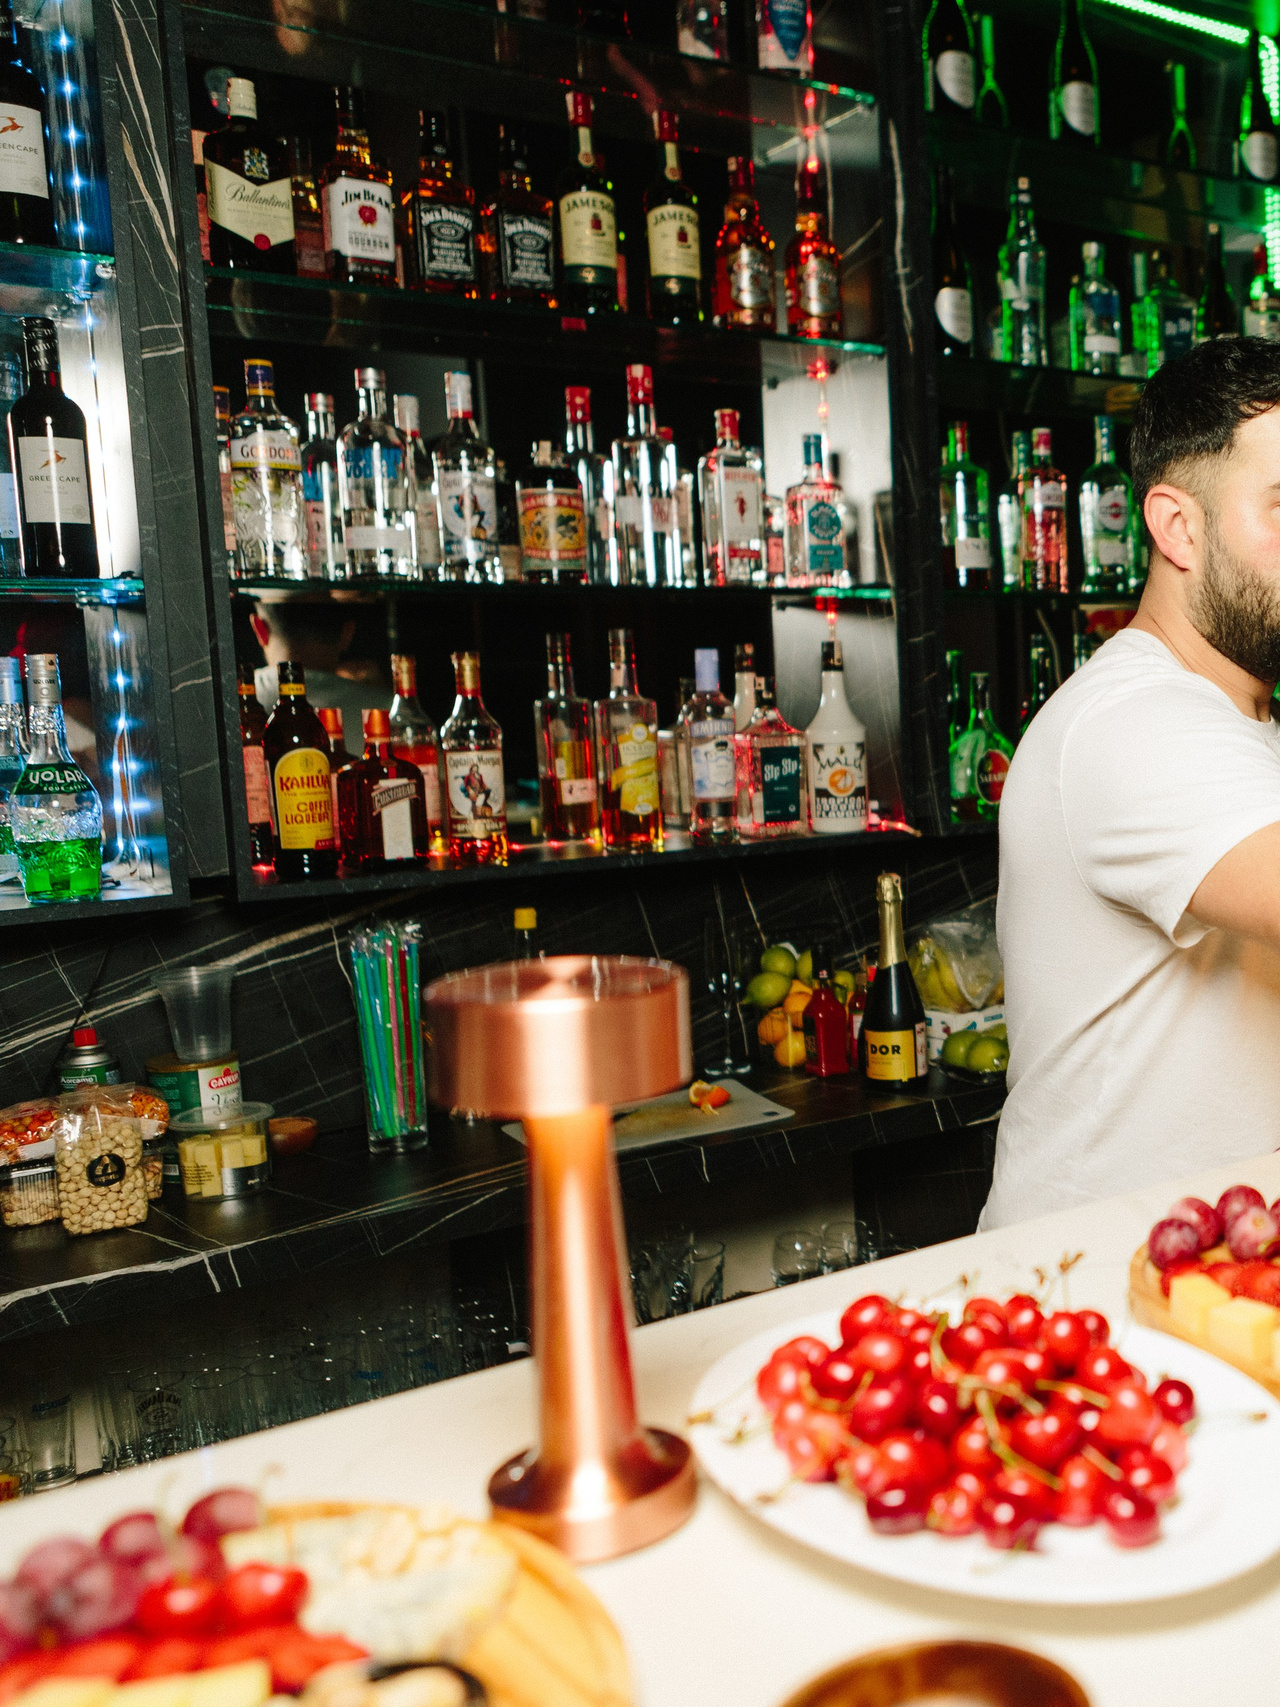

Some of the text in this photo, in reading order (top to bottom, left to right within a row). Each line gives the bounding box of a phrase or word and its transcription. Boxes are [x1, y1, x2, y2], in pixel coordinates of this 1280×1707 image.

[16, 144, 39, 155] CAPE
[341, 190, 361, 206] JIM
[29, 474, 82, 484] GREE CAPE
